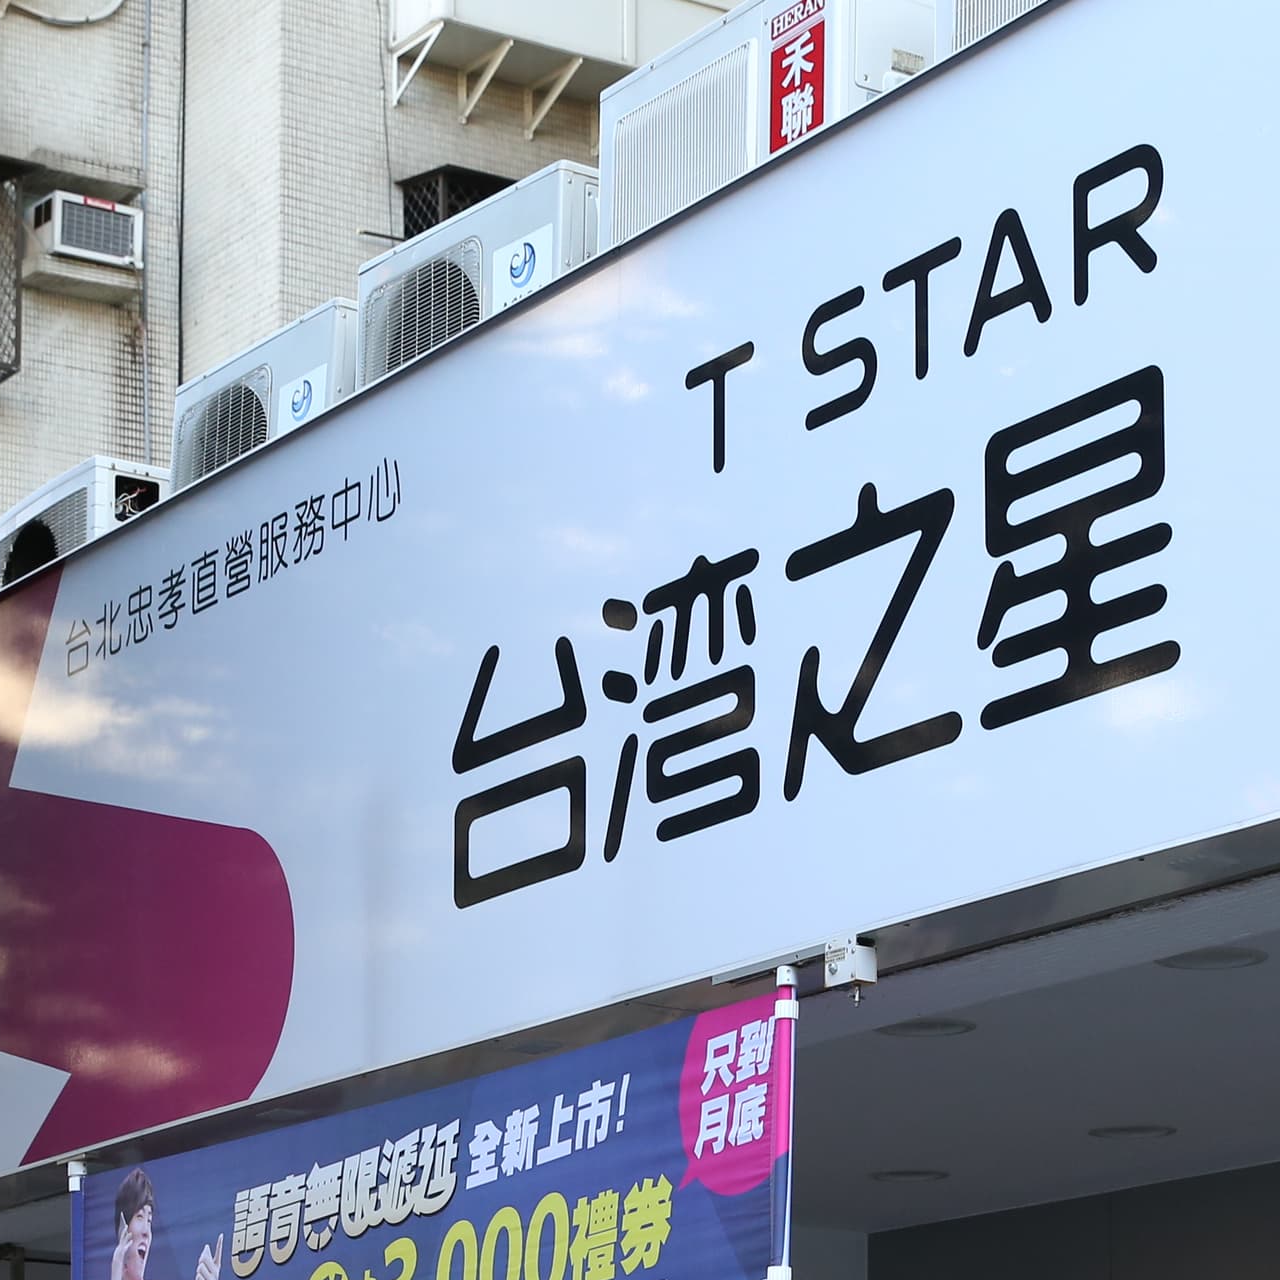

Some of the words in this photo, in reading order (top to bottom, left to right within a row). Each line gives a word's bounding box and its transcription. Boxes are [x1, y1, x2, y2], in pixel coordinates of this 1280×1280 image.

[780, 31, 814, 143] 禾聯
[685, 341, 755, 473] T
[802, 144, 1164, 431] STAR
[66, 457, 401, 677] 台北忠孝直營服務中心
[694, 1082, 769, 1160] 月底
[700, 1015, 776, 1097] 只到
[231, 1118, 460, 1278] 語音無限遞延
